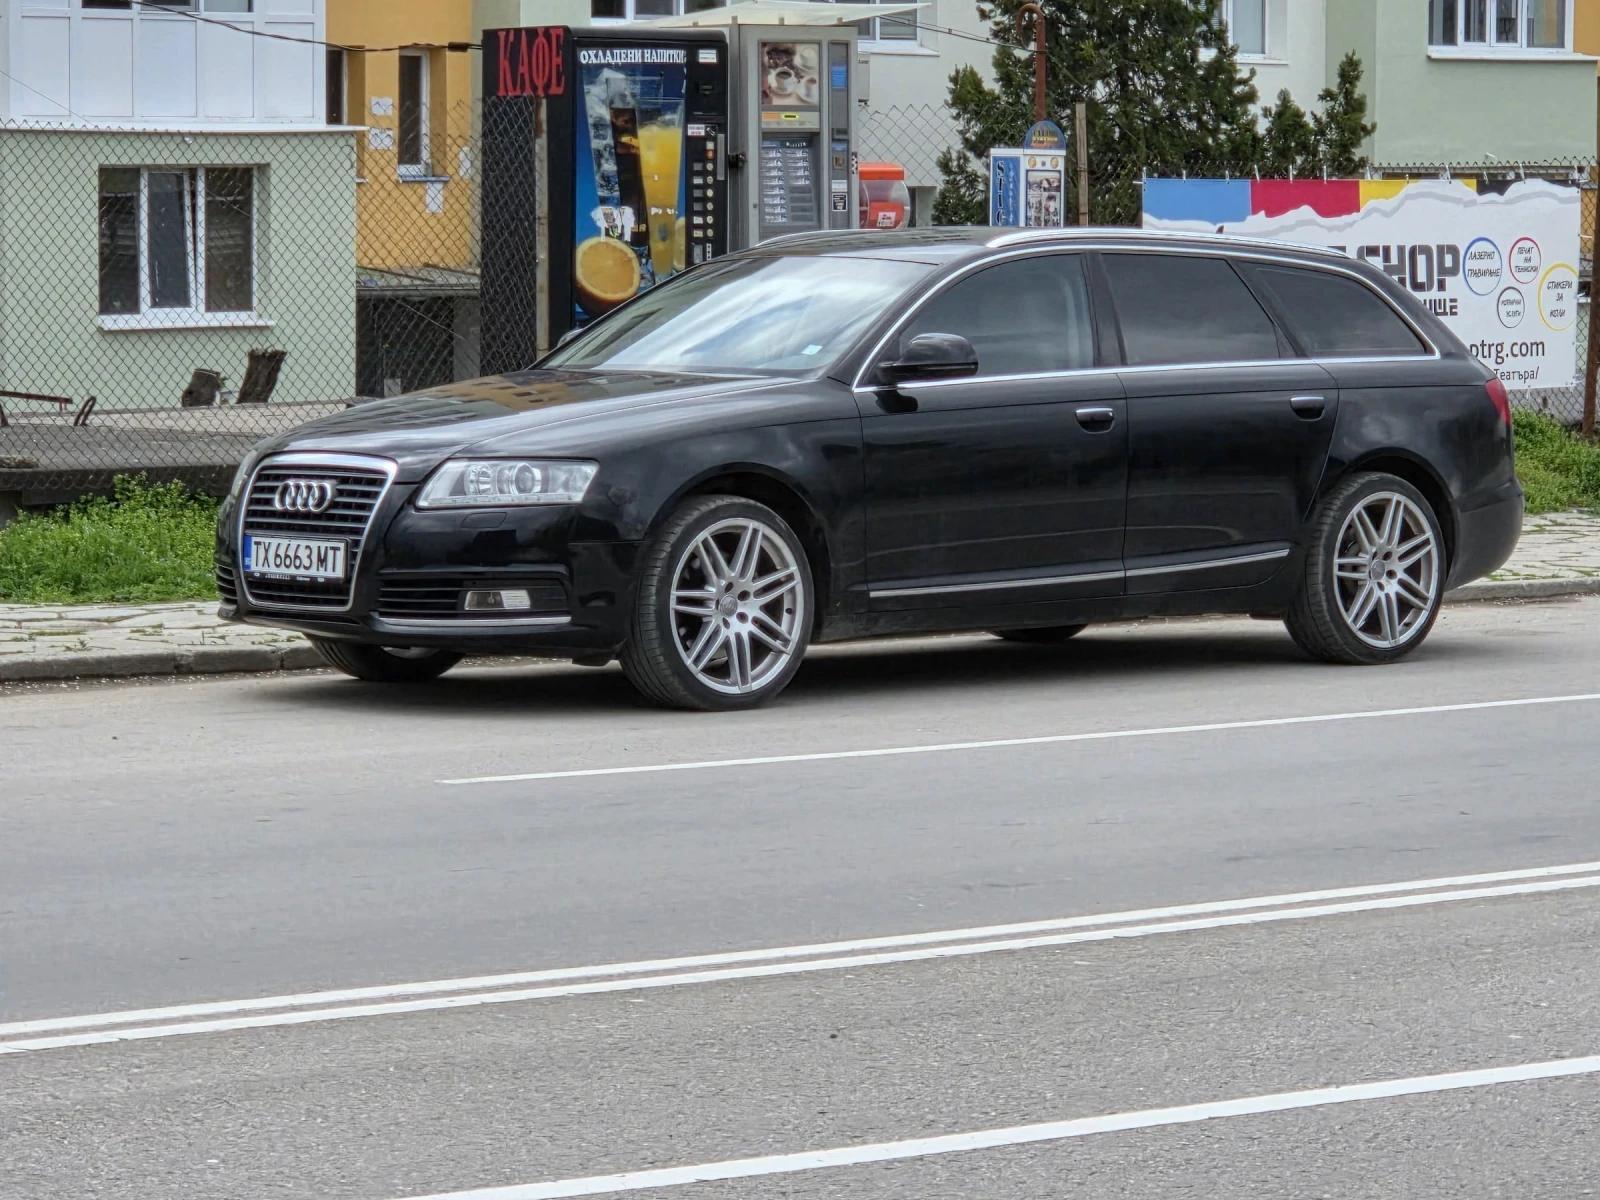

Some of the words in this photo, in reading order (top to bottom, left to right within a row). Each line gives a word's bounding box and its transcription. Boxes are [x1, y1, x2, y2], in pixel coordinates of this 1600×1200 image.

[497, 26, 565, 97] КАФЕ
[580, 49, 642, 65] ОХЛАДЕНИ
[644, 49, 686, 63] НАПИТКИ
[1468, 251, 1495, 260] ЛАЗЕРНО
[1517, 247, 1534, 255] ПЕЧАТ
[1467, 268, 1501, 278] ГРАВИРАНЕ
[1547, 280, 1573, 290] СТИКЕРИ
